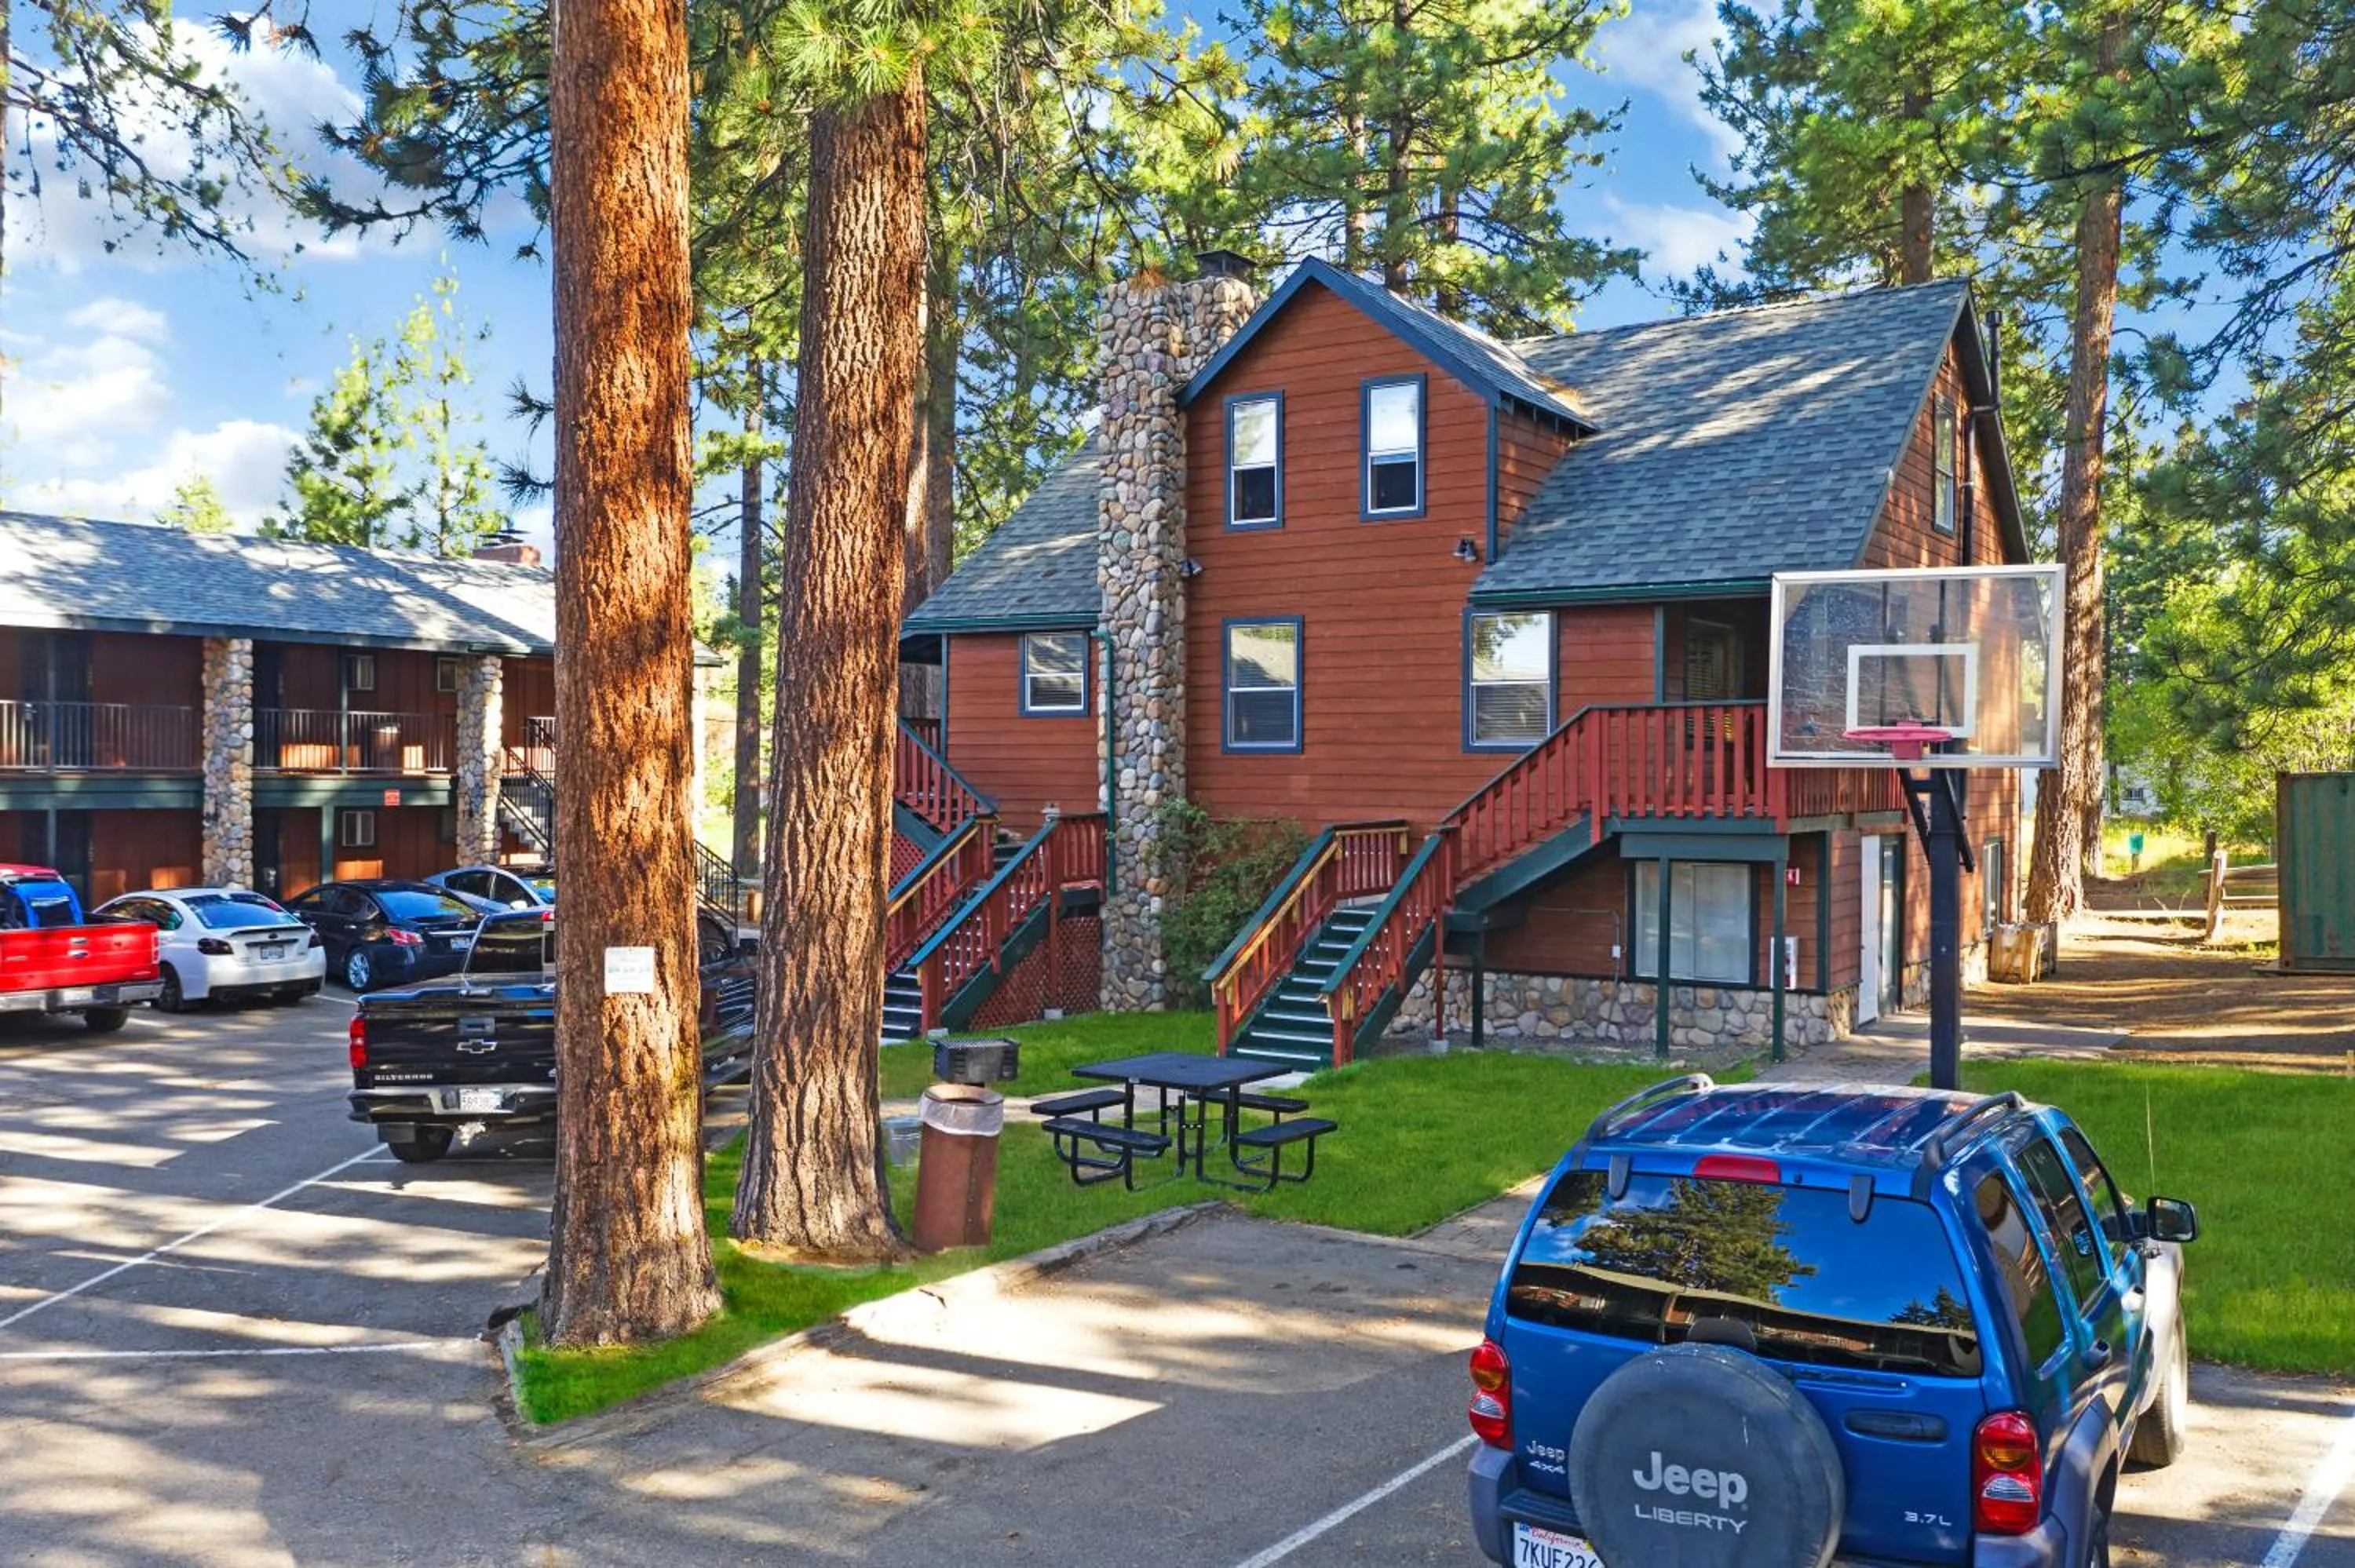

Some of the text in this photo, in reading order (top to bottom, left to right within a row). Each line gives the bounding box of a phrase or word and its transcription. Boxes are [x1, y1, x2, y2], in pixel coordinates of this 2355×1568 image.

[1525, 1440, 1565, 1463] Jeep
[1632, 1450, 1747, 1510] Jeep
[1634, 1503, 1748, 1534] LIBERTY
[1904, 1511, 1952, 1527] 3.7L
